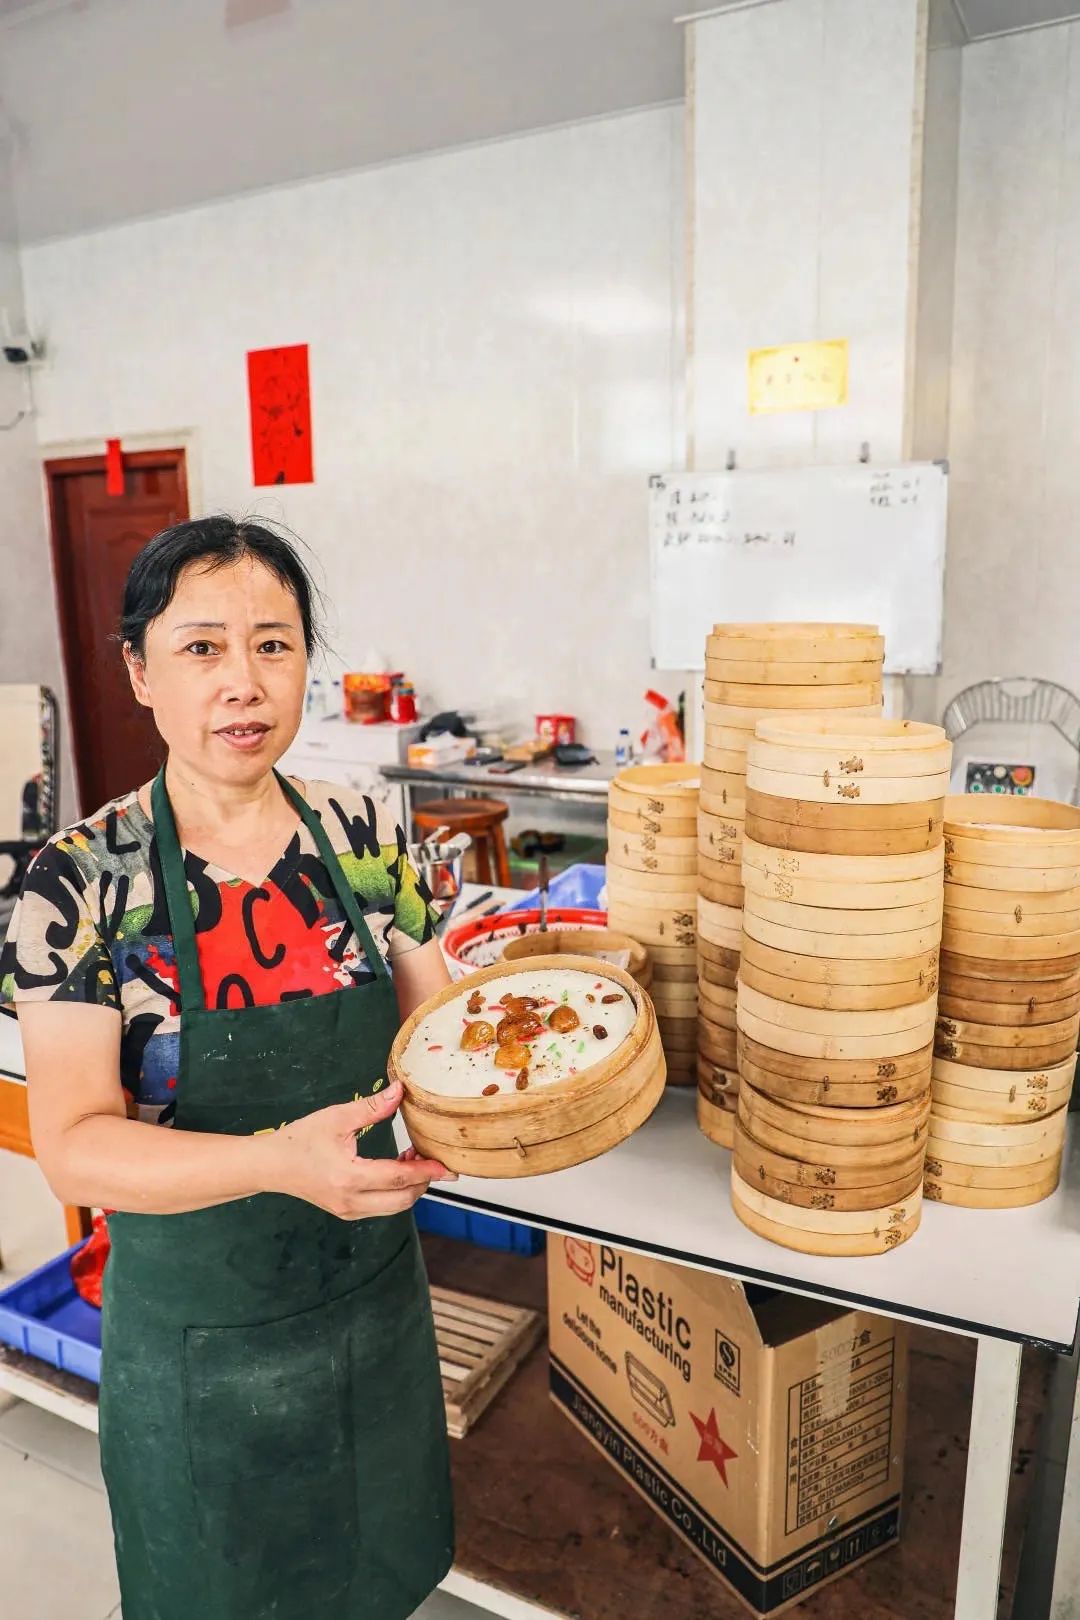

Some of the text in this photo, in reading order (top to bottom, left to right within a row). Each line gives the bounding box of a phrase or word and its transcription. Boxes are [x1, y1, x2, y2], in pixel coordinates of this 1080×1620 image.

[599, 1284, 691, 1383] manufacturing
[600, 1244, 691, 1350] Plastic
[573, 1394, 621, 1456] Jiangyin
[623, 1449, 669, 1505] Plastic
